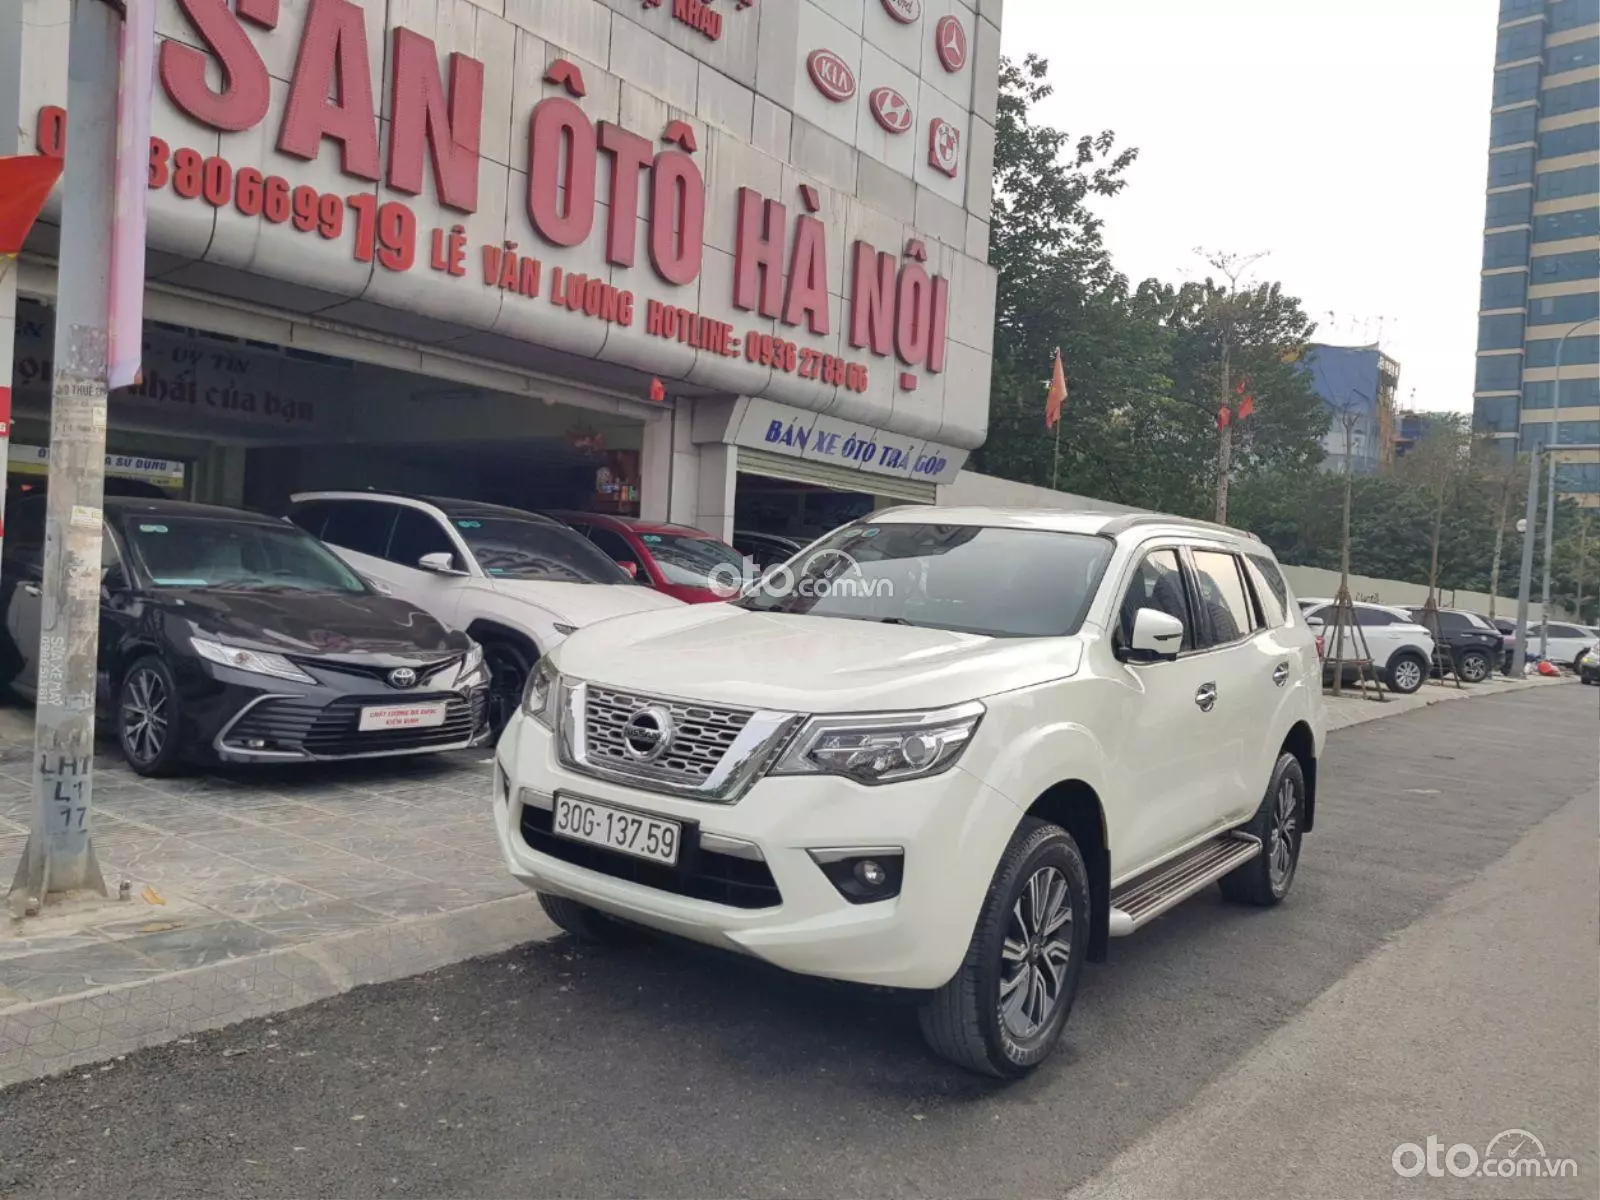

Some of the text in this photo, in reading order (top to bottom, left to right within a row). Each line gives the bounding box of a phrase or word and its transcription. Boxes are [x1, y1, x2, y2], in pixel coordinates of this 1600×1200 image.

[820, 60, 849, 91] KIA
[431, 224, 467, 277] LÊ
[483, 240, 541, 298] VĂN
[551, 266, 634, 327] LƯƠNG
[647, 298, 741, 357] HOTLINE:
[746, 331, 797, 373] 0936
[733, 184, 829, 335] HÀ
[848, 238, 949, 392] NỘI
[764, 416, 814, 451] BÁN
[811, 430, 841, 456] XE
[914, 450, 948, 476] GÓP
[558, 801, 675, 858] 30G-137.59
